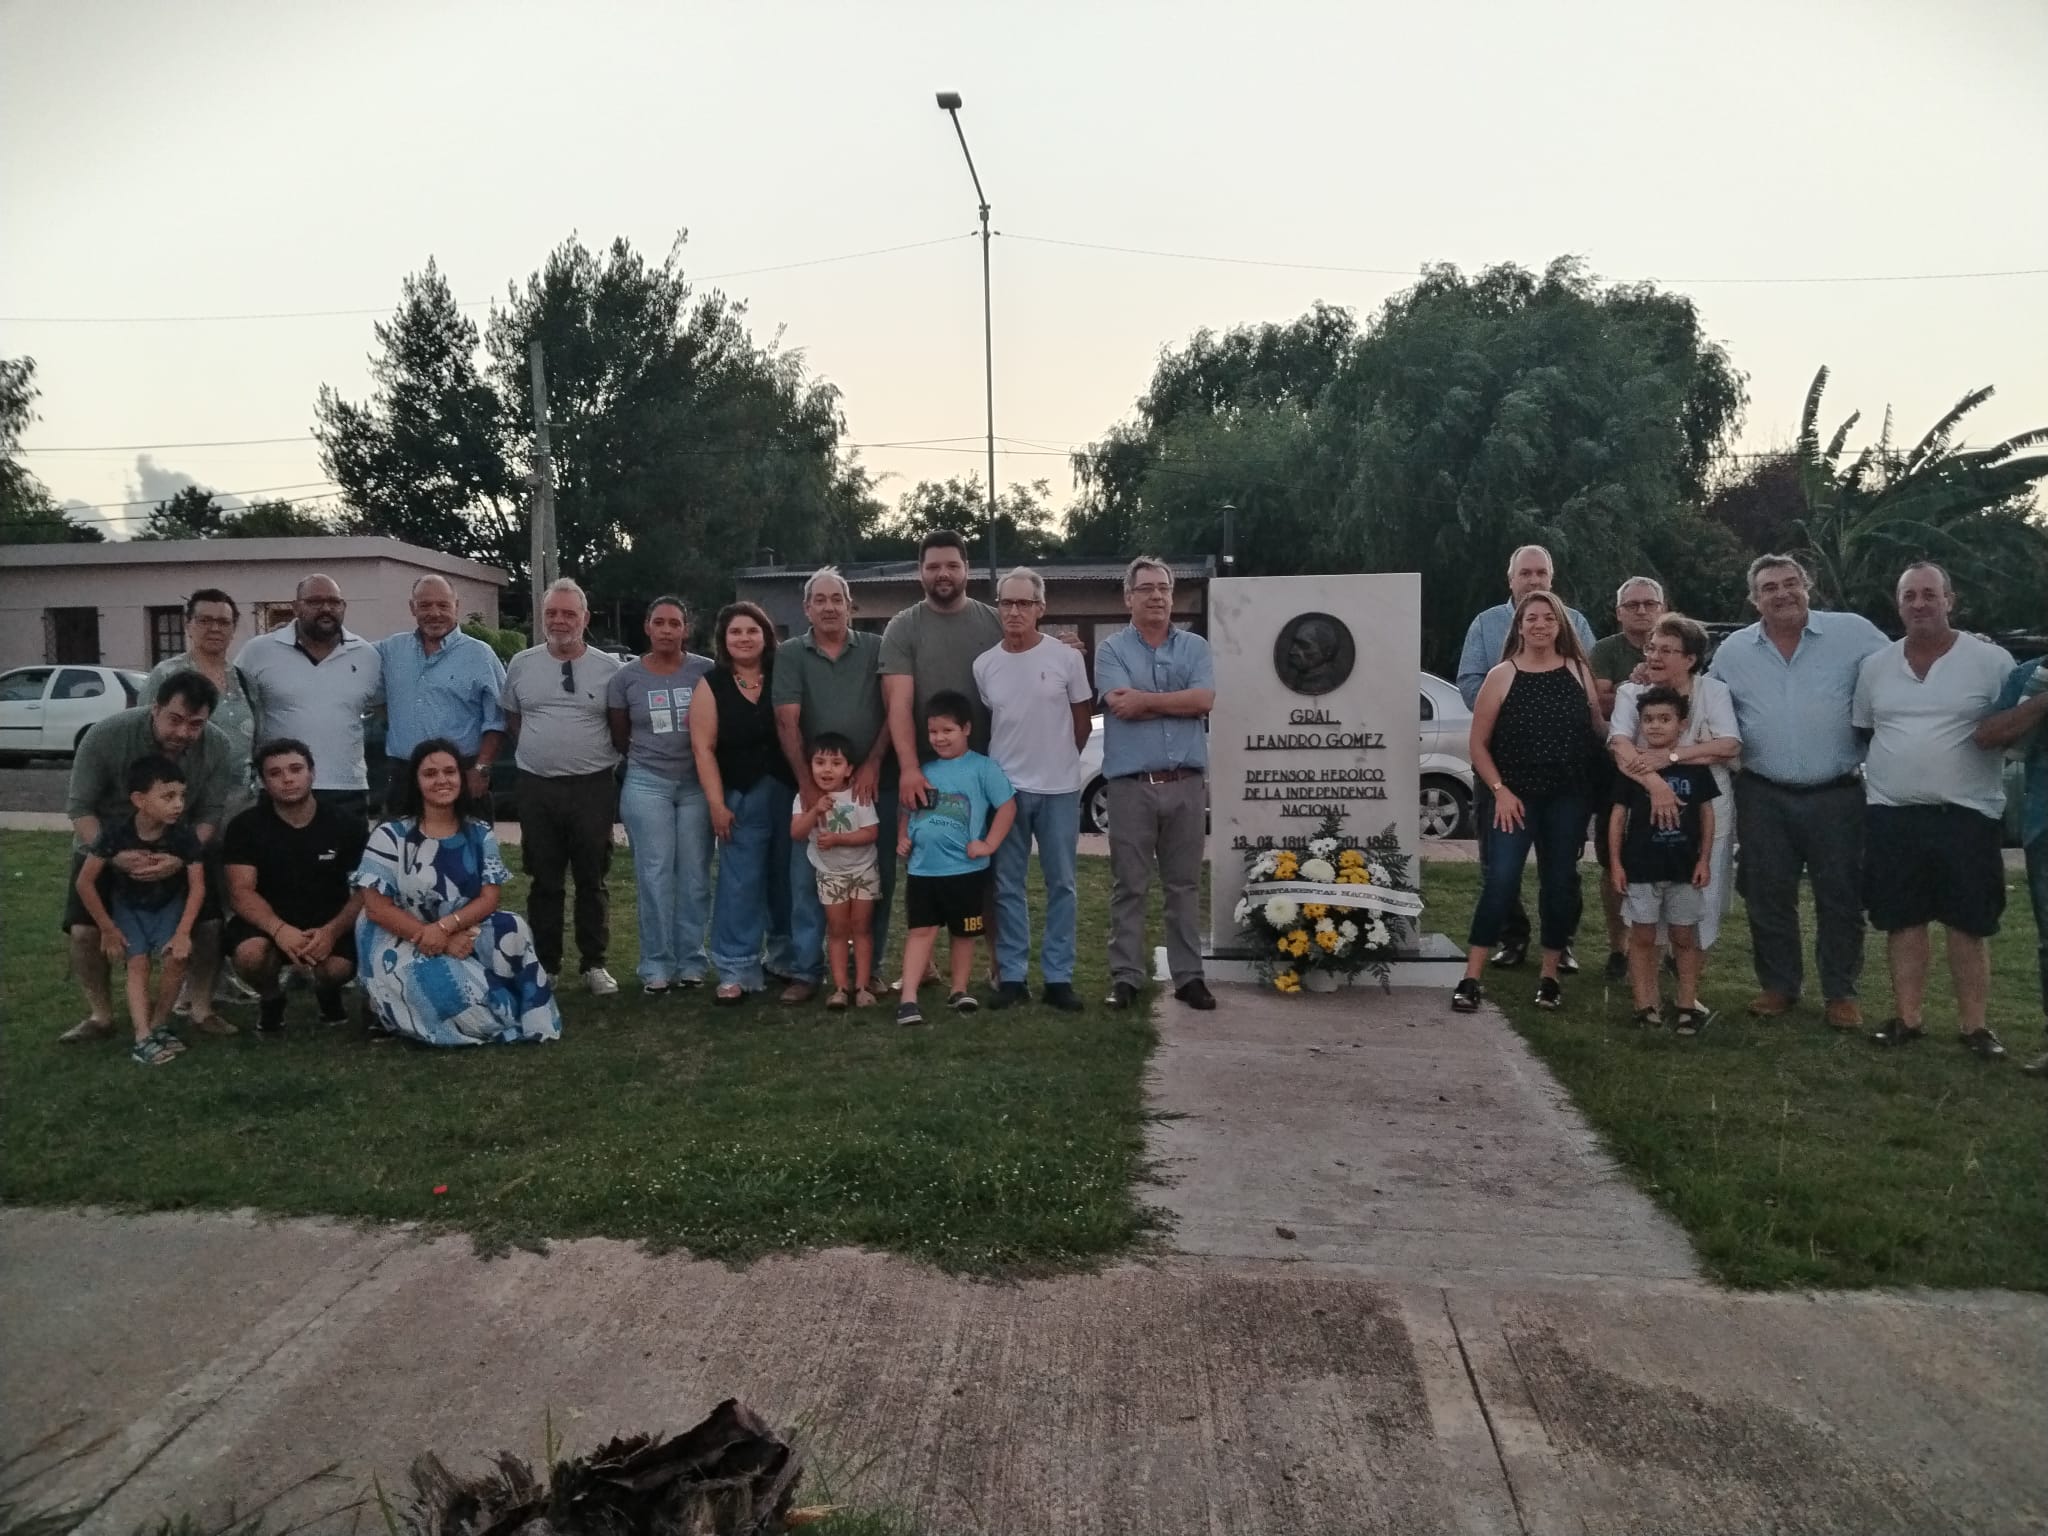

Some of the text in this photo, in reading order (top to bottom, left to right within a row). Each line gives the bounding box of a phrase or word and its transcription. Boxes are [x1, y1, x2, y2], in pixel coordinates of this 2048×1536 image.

[1290, 708, 1340, 724] GRAL.
[1246, 732, 1385, 749] LEANDRO GOMEZ
[1246, 769, 1315, 782] DEFENSOR
[1245, 786, 1386, 799] DE LA INDEPENDENCIA
[1282, 804, 1351, 816] NACIONAL
